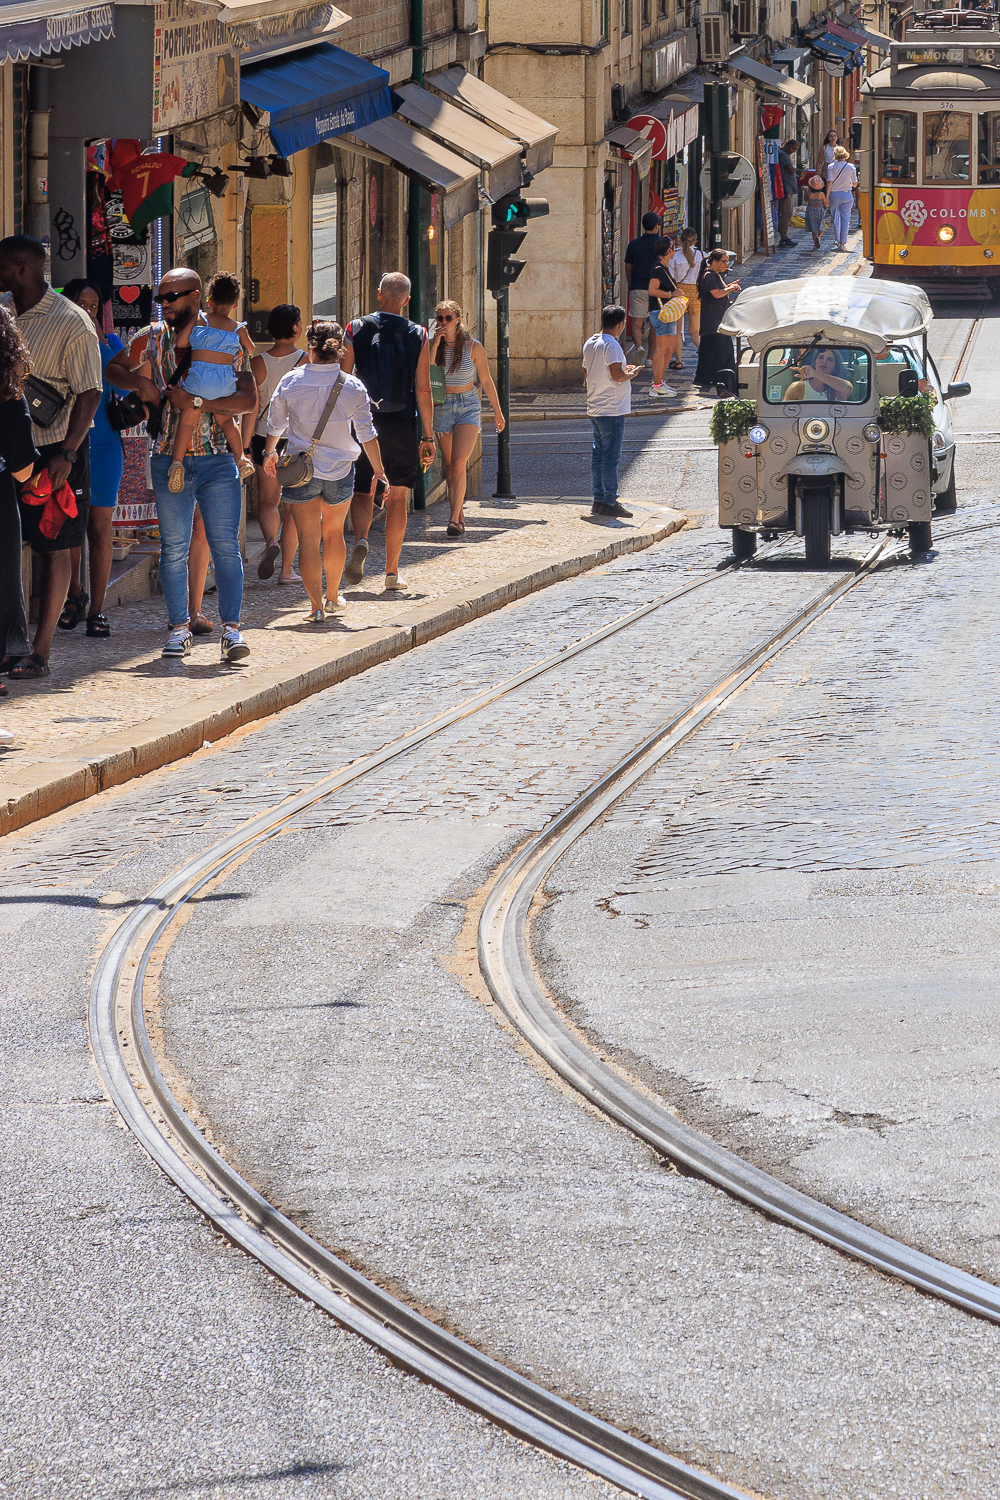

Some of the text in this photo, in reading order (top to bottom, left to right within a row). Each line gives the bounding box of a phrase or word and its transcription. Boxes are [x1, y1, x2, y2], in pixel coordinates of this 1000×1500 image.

[91, 4, 112, 29] SHOP
[928, 50, 963, 61] MONIZ
[975, 49, 995, 62] 28
[131, 161, 163, 175] RONALDO
[136, 171, 150, 199] 7
[929, 208, 997, 219] COLOMB
[112, 304, 142, 319] SBOA
